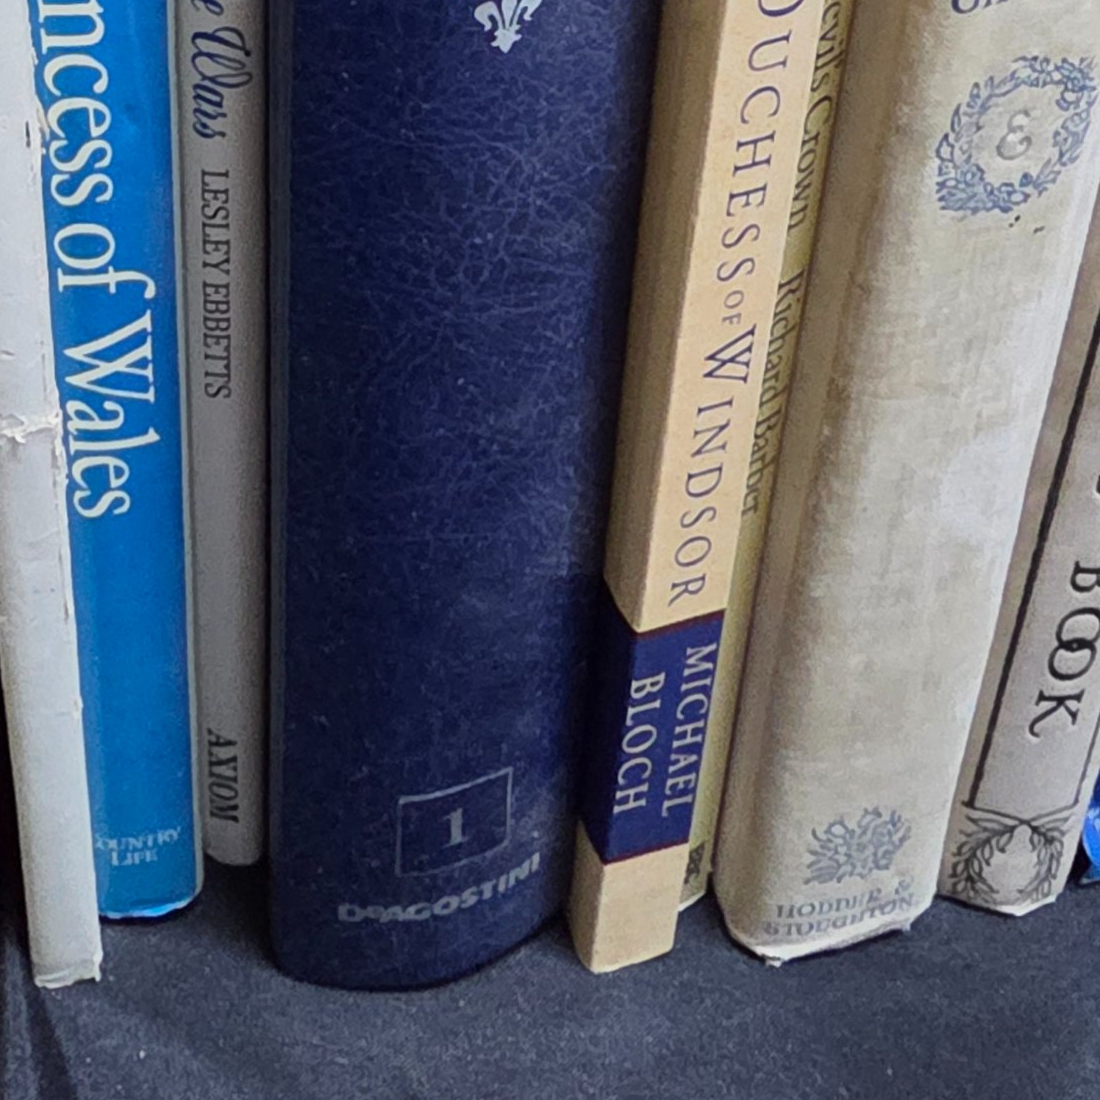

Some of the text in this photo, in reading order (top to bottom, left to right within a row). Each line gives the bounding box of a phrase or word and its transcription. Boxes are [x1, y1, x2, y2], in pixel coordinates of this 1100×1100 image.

[191, 26, 253, 139] Wars
[786, 95, 834, 232] Crown
[53, 222, 155, 300] of
[202, 169, 233, 400] LESLEY EBBETTS
[720, 289, 745, 326] OF
[62, 309, 160, 518] Wales
[742, 268, 804, 517] Richard Barber
[667, 323, 758, 608] WINDSOR
[613, 671, 666, 816] BLOCH
[661, 642, 717, 818] MICHAEL
[443, 807, 468, 848] 1
